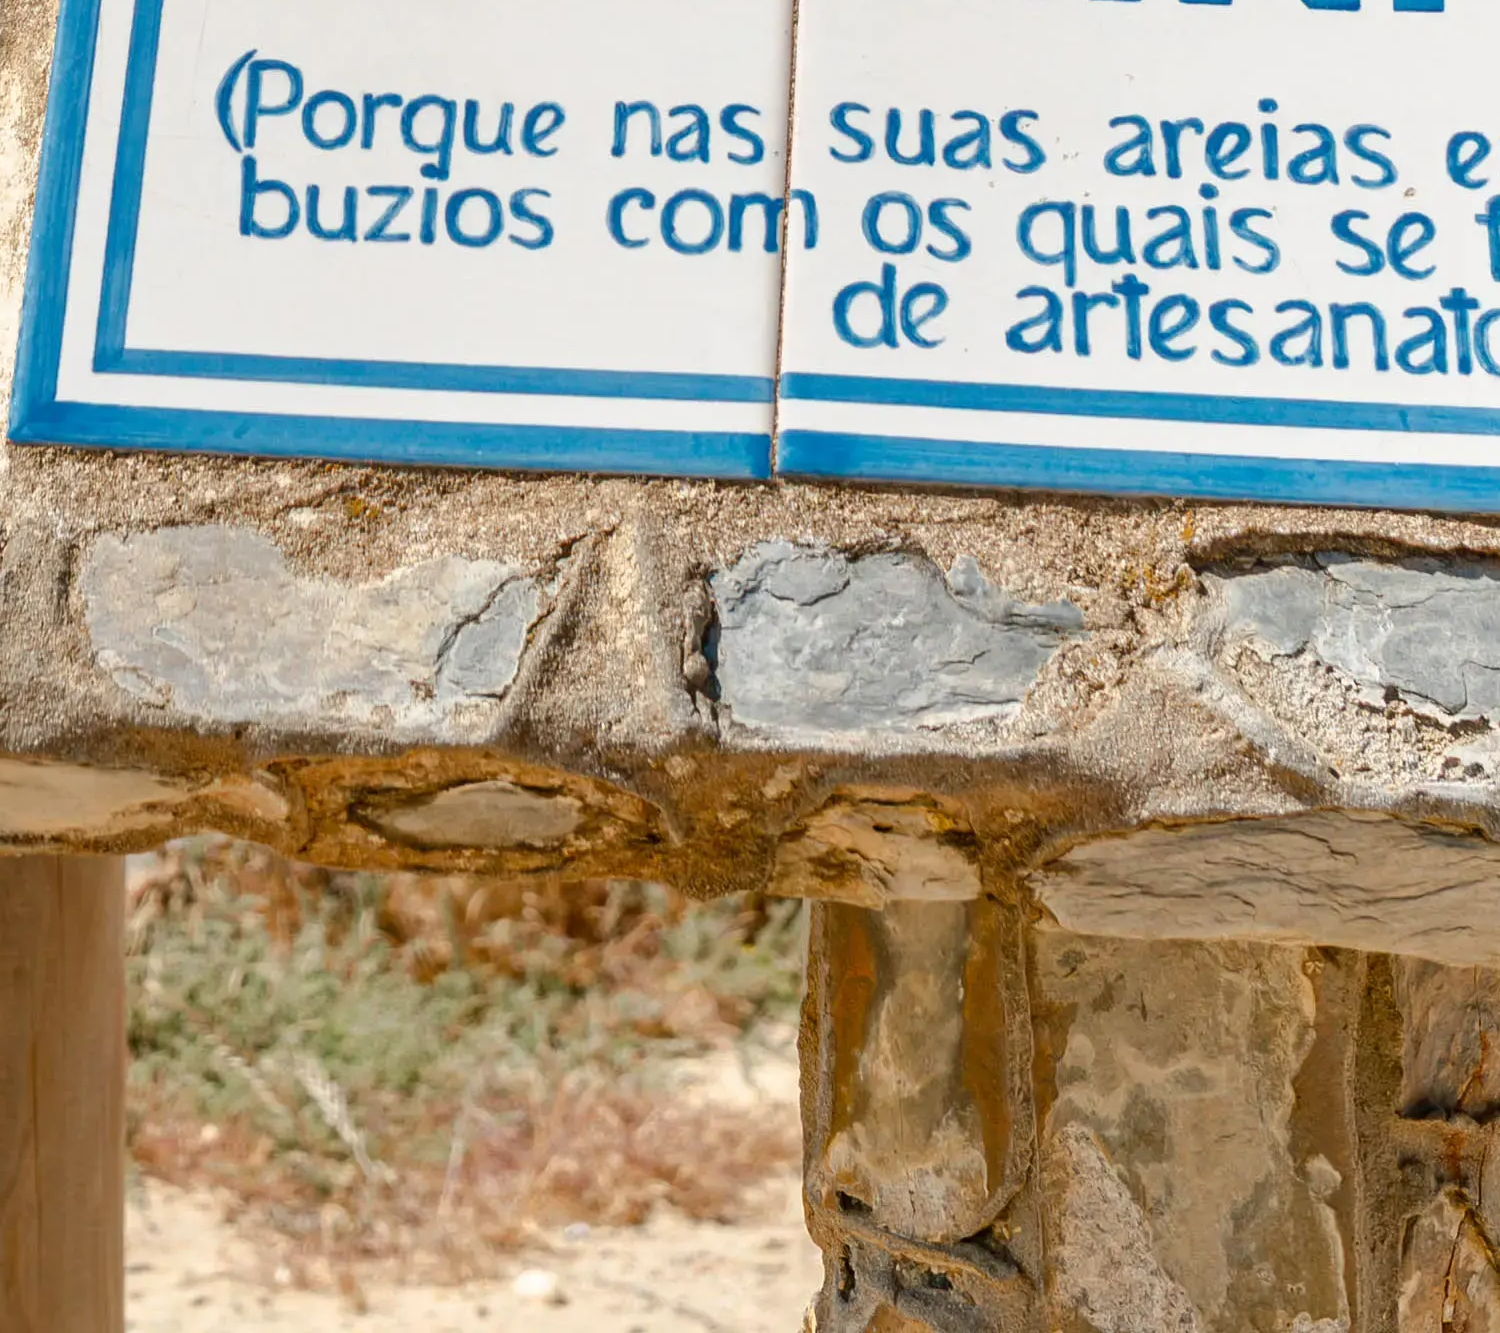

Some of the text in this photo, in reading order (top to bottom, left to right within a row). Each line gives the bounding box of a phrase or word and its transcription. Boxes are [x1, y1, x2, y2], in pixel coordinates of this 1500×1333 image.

[214, 47, 567, 173] (Porque
[611, 100, 766, 166] nas
[829, 101, 1047, 175] suas
[1103, 97, 1399, 190] areias
[238, 153, 555, 251] buzios
[607, 187, 819, 255] com
[861, 191, 973, 264] os
[1016, 182, 1281, 288] quais
[1330, 207, 1437, 281] se
[832, 261, 949, 350] de
